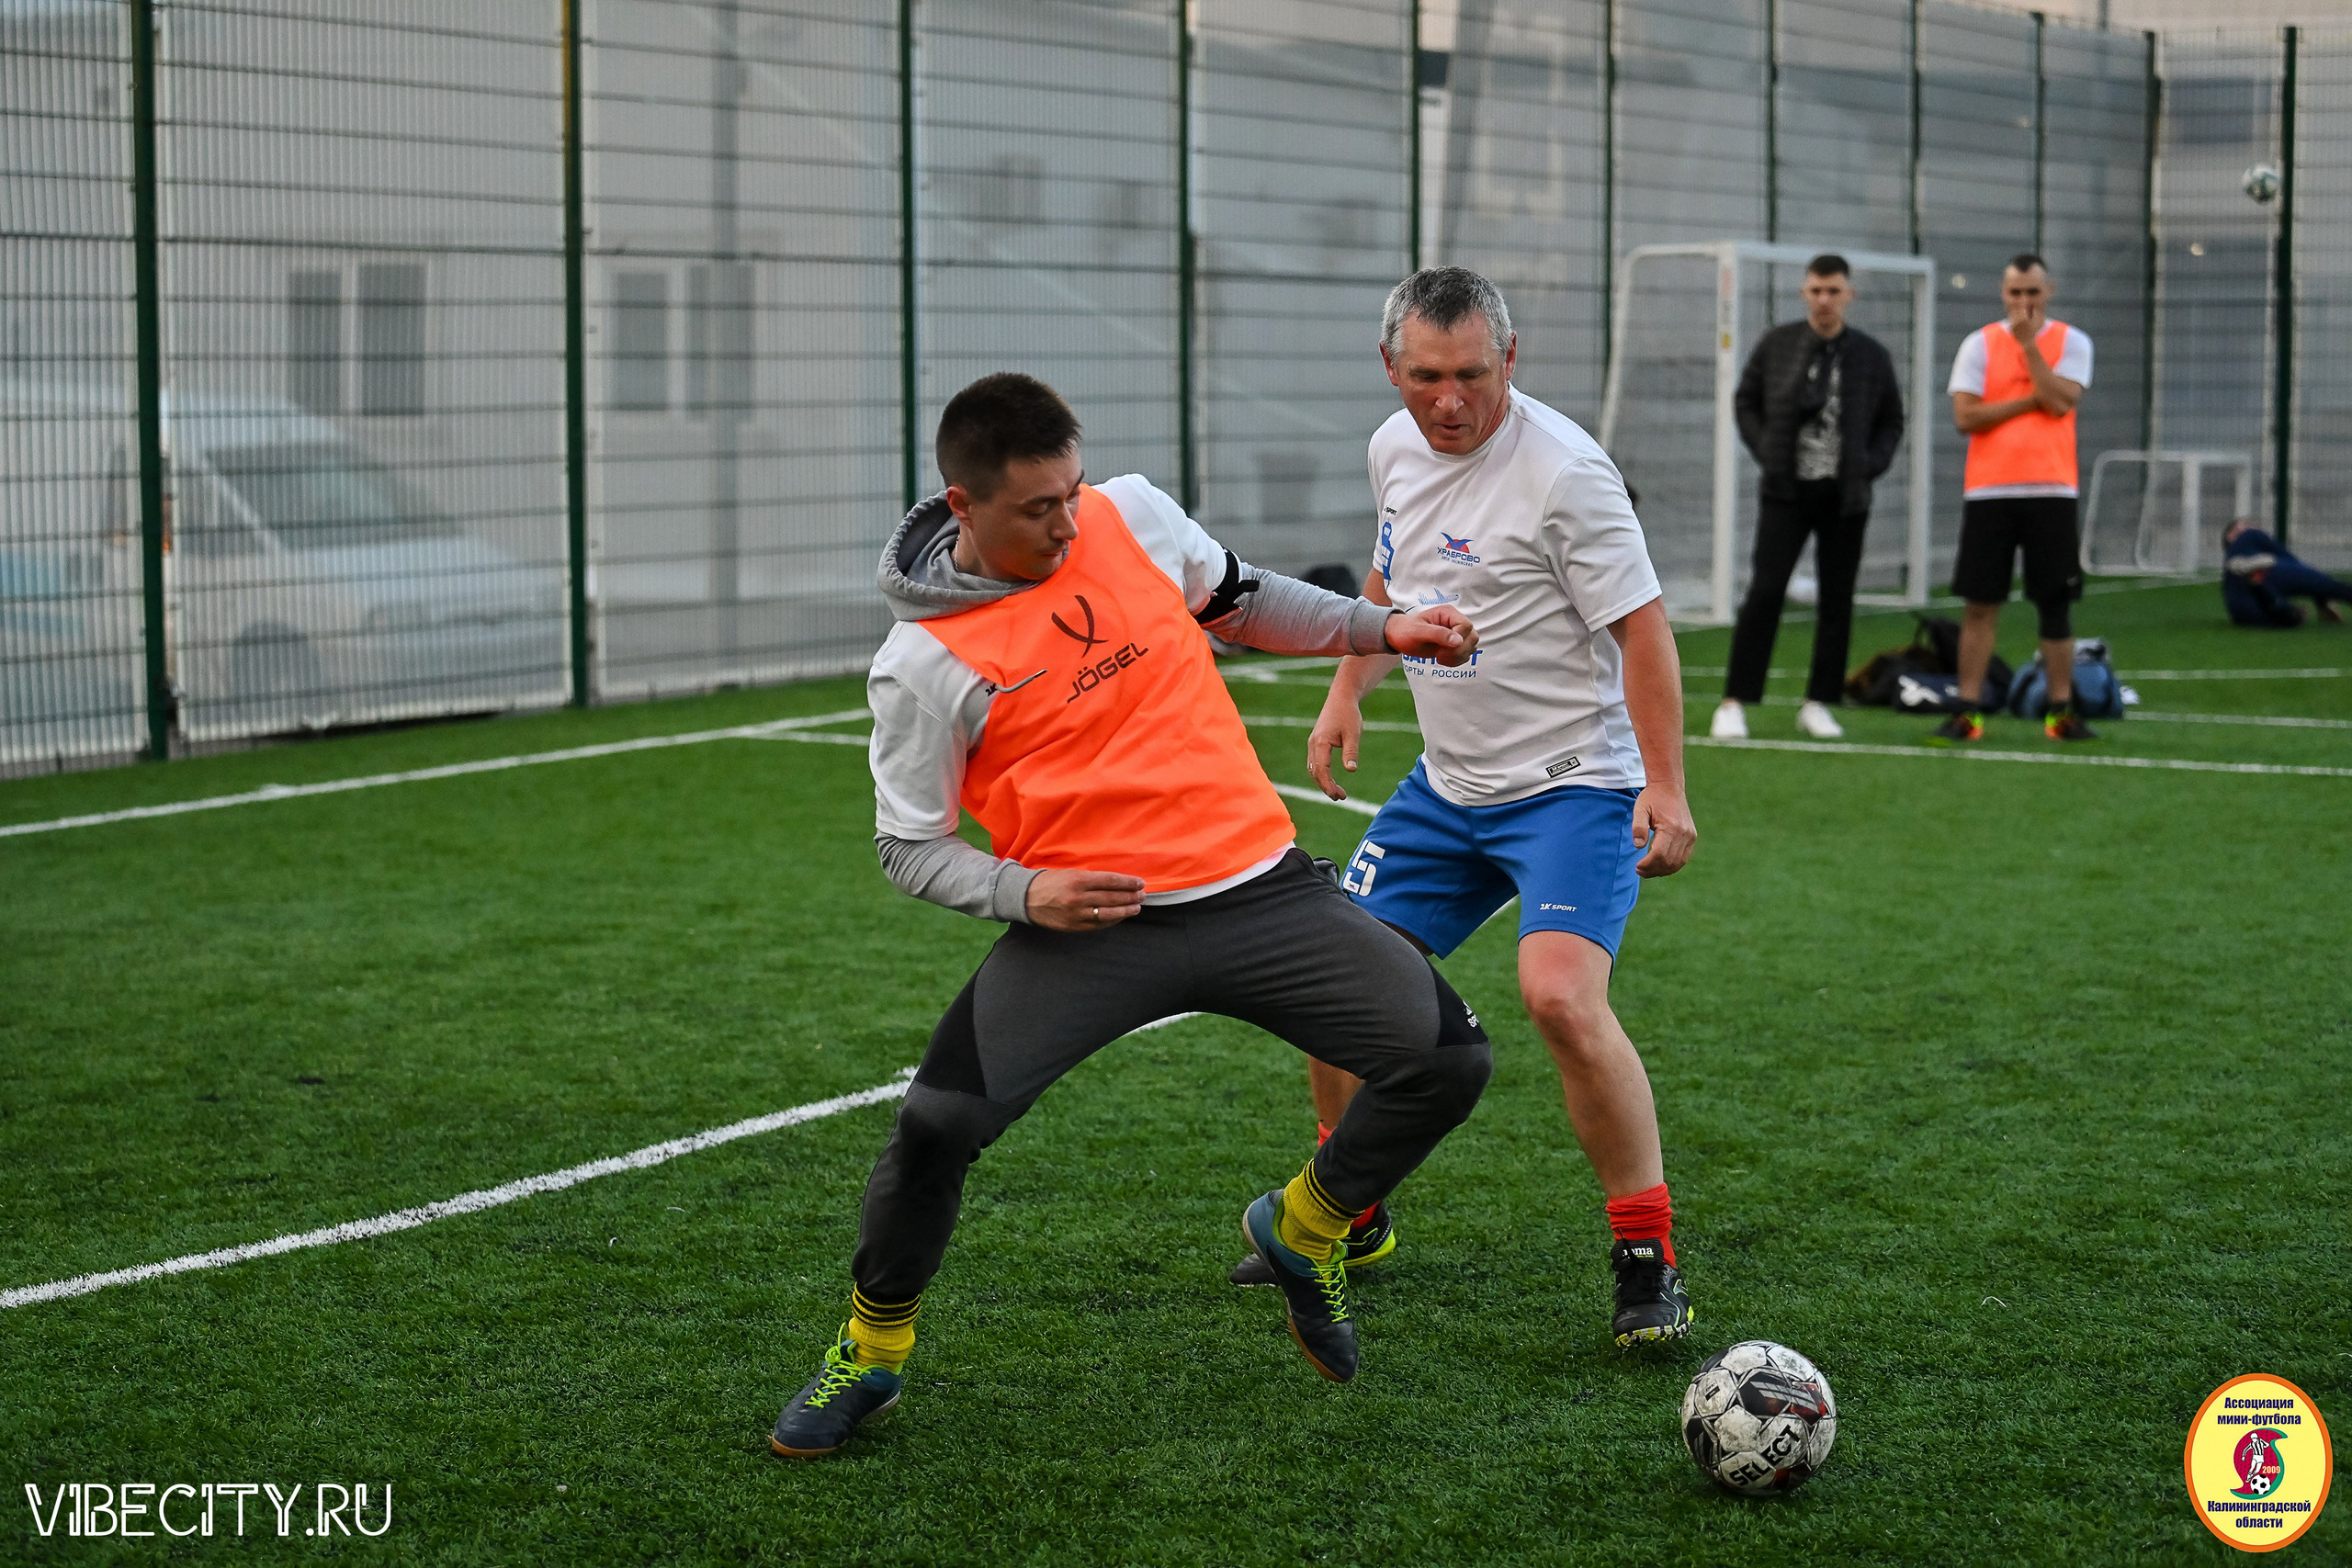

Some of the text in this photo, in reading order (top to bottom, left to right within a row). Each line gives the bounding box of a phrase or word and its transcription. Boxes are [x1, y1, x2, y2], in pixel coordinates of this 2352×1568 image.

[1437, 547, 1481, 564] ХРАБРОВО
[1067, 642, 1148, 704] JÖGEL
[1404, 664, 1476, 678] ОРТЫ РОССИИ
[1552, 904, 1577, 912] SPORT
[1729, 1424, 1801, 1486] SELECT
